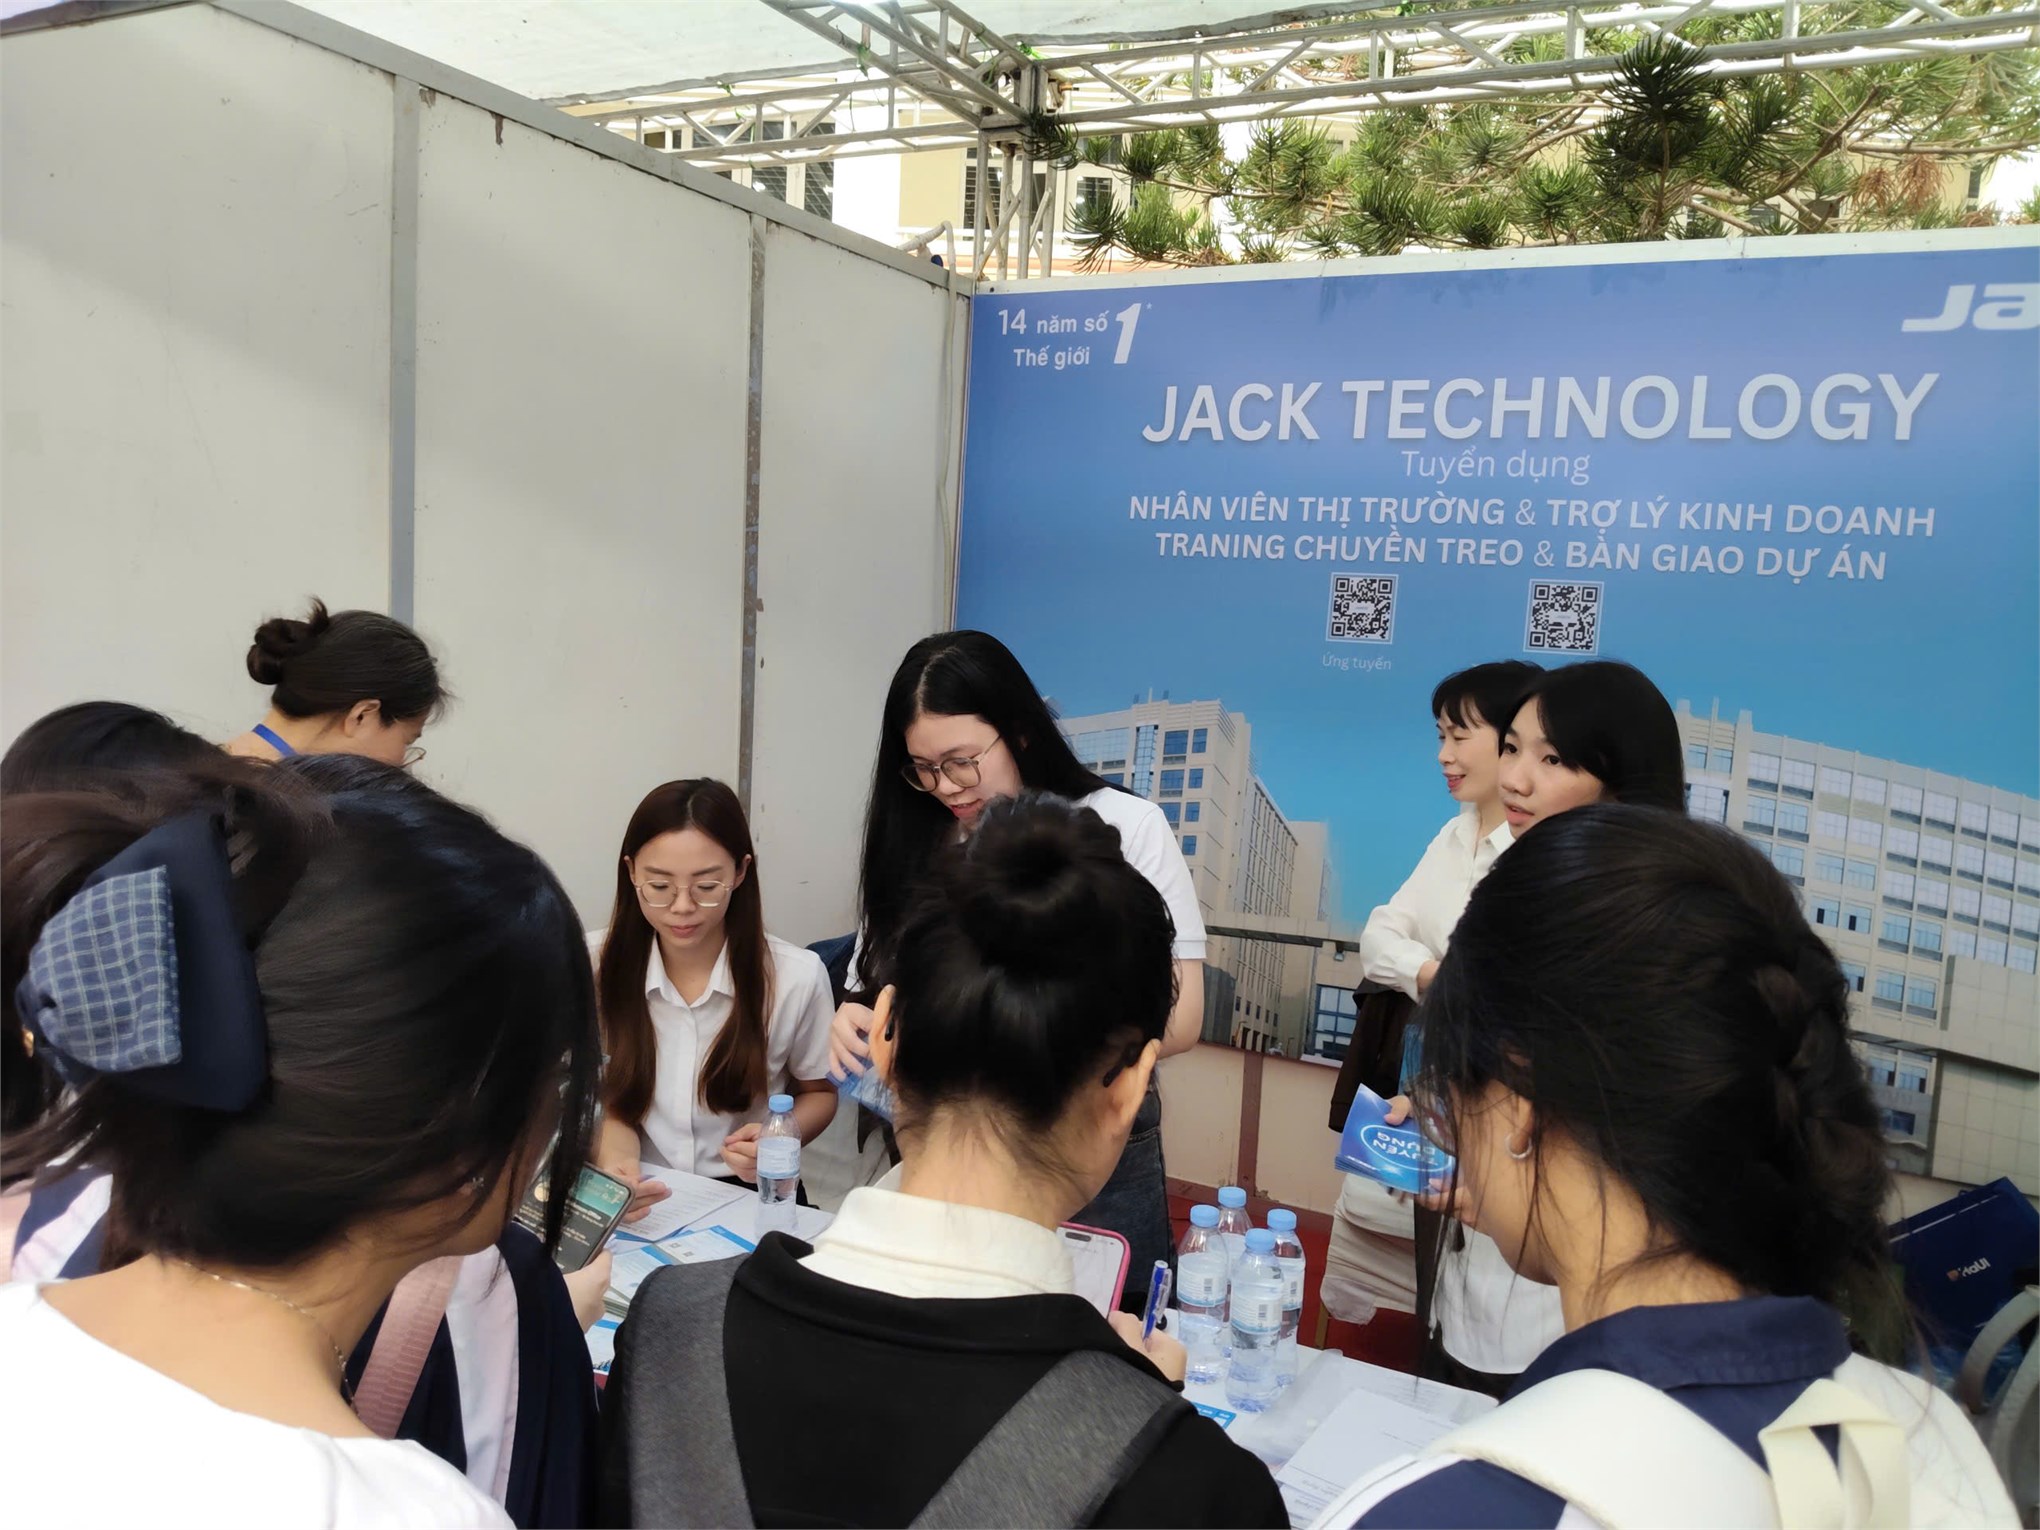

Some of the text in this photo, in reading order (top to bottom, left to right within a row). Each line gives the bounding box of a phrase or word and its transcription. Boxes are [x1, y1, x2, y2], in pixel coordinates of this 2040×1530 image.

[999, 309, 1026, 335] 14
[1037, 315, 1077, 333] năm
[1084, 310, 1109, 332] số
[1014, 345, 1090, 370] Thế giới
[1143, 373, 1939, 441] JACK TECHNOLOGY
[1401, 445, 1590, 485] Tuyển dụng
[1130, 490, 1935, 536] NHÂN VIÊN THỊ TRƯỜNG & TRỢ LÝ KINH DOANH
[1156, 524, 1885, 583] TRANING CHUYỀN TREO & BÀN GIAO DỰ ÁN
